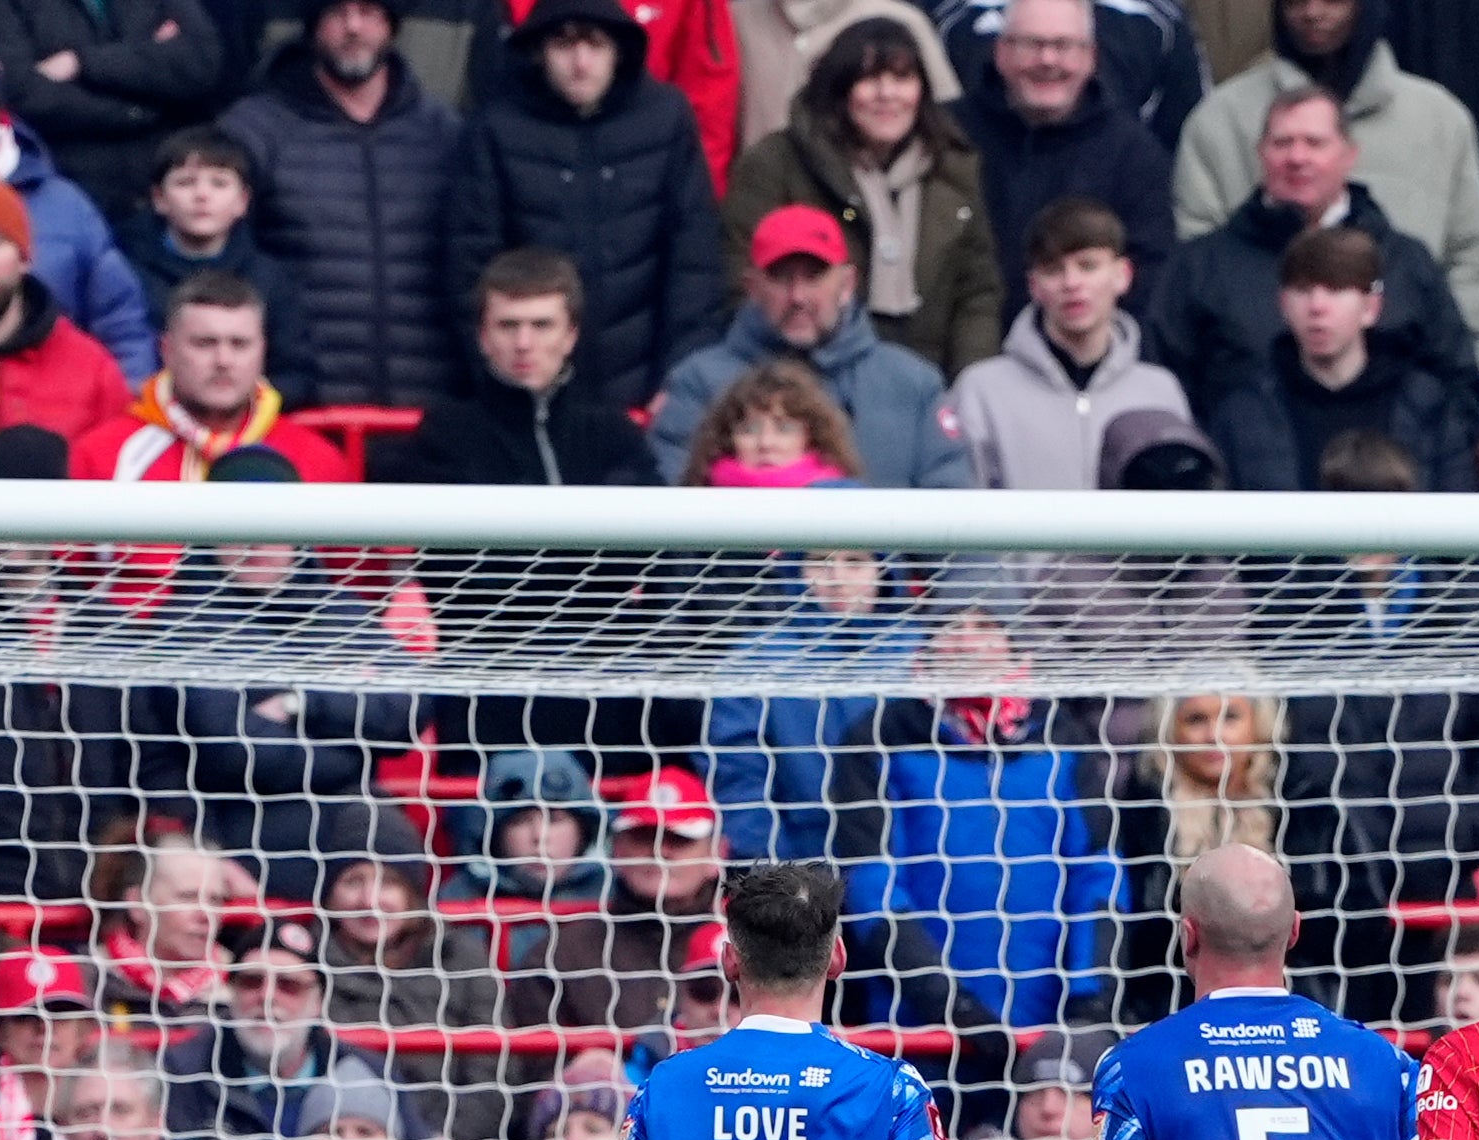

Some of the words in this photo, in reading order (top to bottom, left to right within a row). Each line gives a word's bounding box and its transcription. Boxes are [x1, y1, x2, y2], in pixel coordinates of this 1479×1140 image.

[1199, 1022, 1286, 1039] Sundown
[705, 1067, 790, 1087] Sundown
[1184, 1055, 1351, 1093] RAWSON
